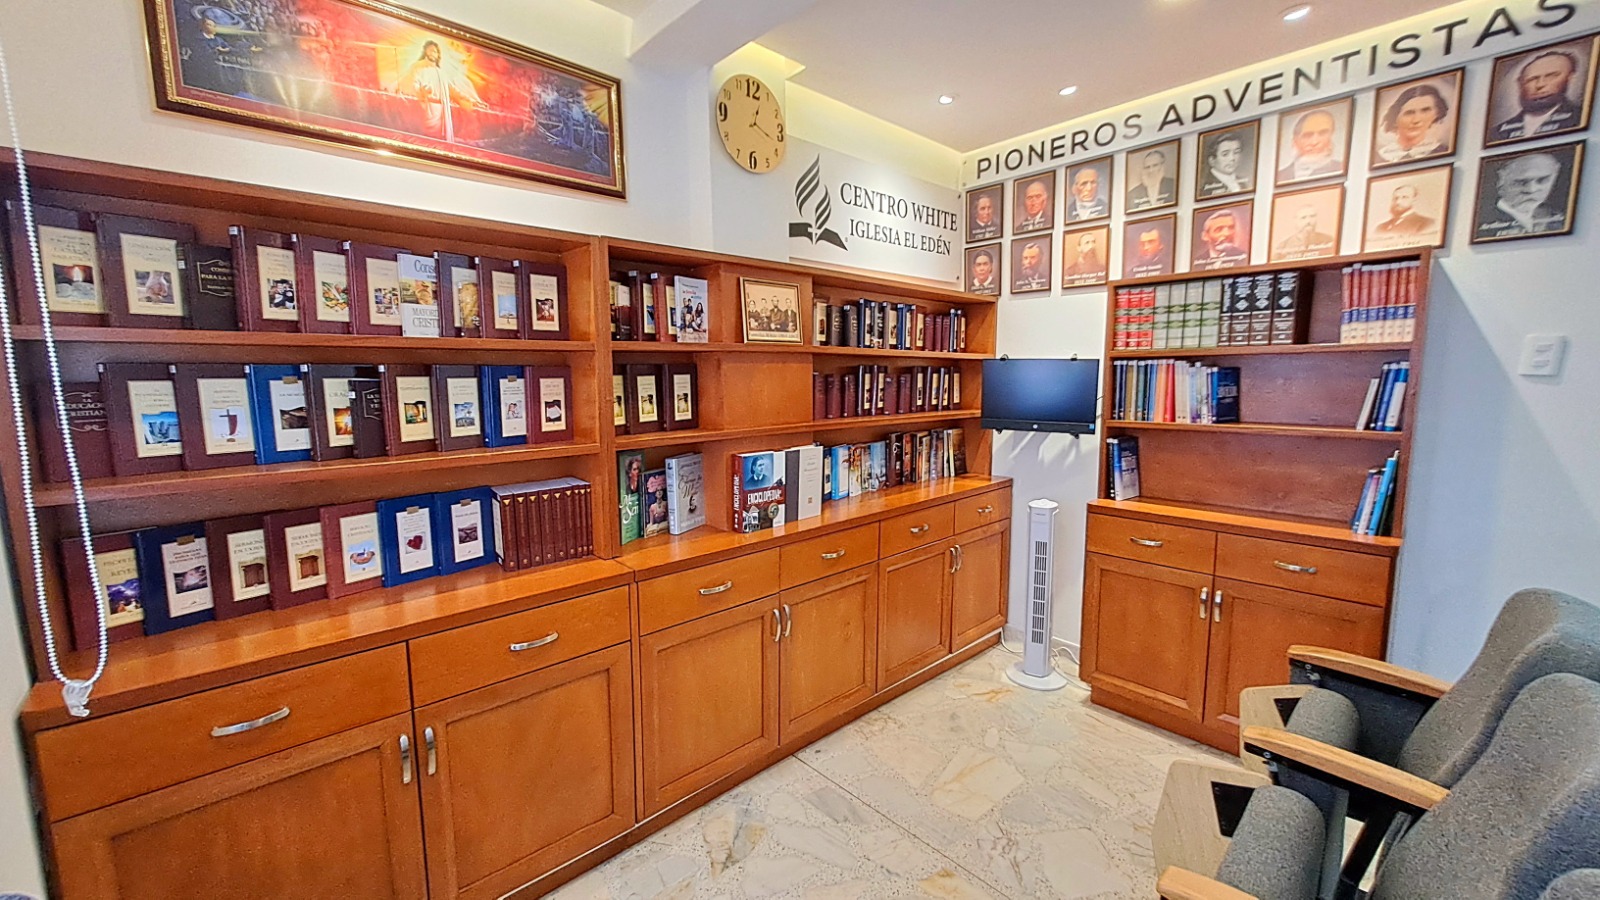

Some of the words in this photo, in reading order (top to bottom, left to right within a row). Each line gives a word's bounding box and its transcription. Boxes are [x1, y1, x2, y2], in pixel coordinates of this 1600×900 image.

[745, 78, 760, 101] 12
[977, 114, 1143, 180] PIONEROS
[1157, 0, 1576, 133] ADVENTISTAS
[718, 101, 728, 122] 9
[776, 123, 784, 142] 3
[748, 151, 757, 170] 6
[840, 183, 908, 219] CENTRO
[911, 202, 958, 232] WHITE
[849, 218, 901, 246] IGLESIA
[903, 230, 918, 249] EL
[920, 235, 951, 256] EDÉN
